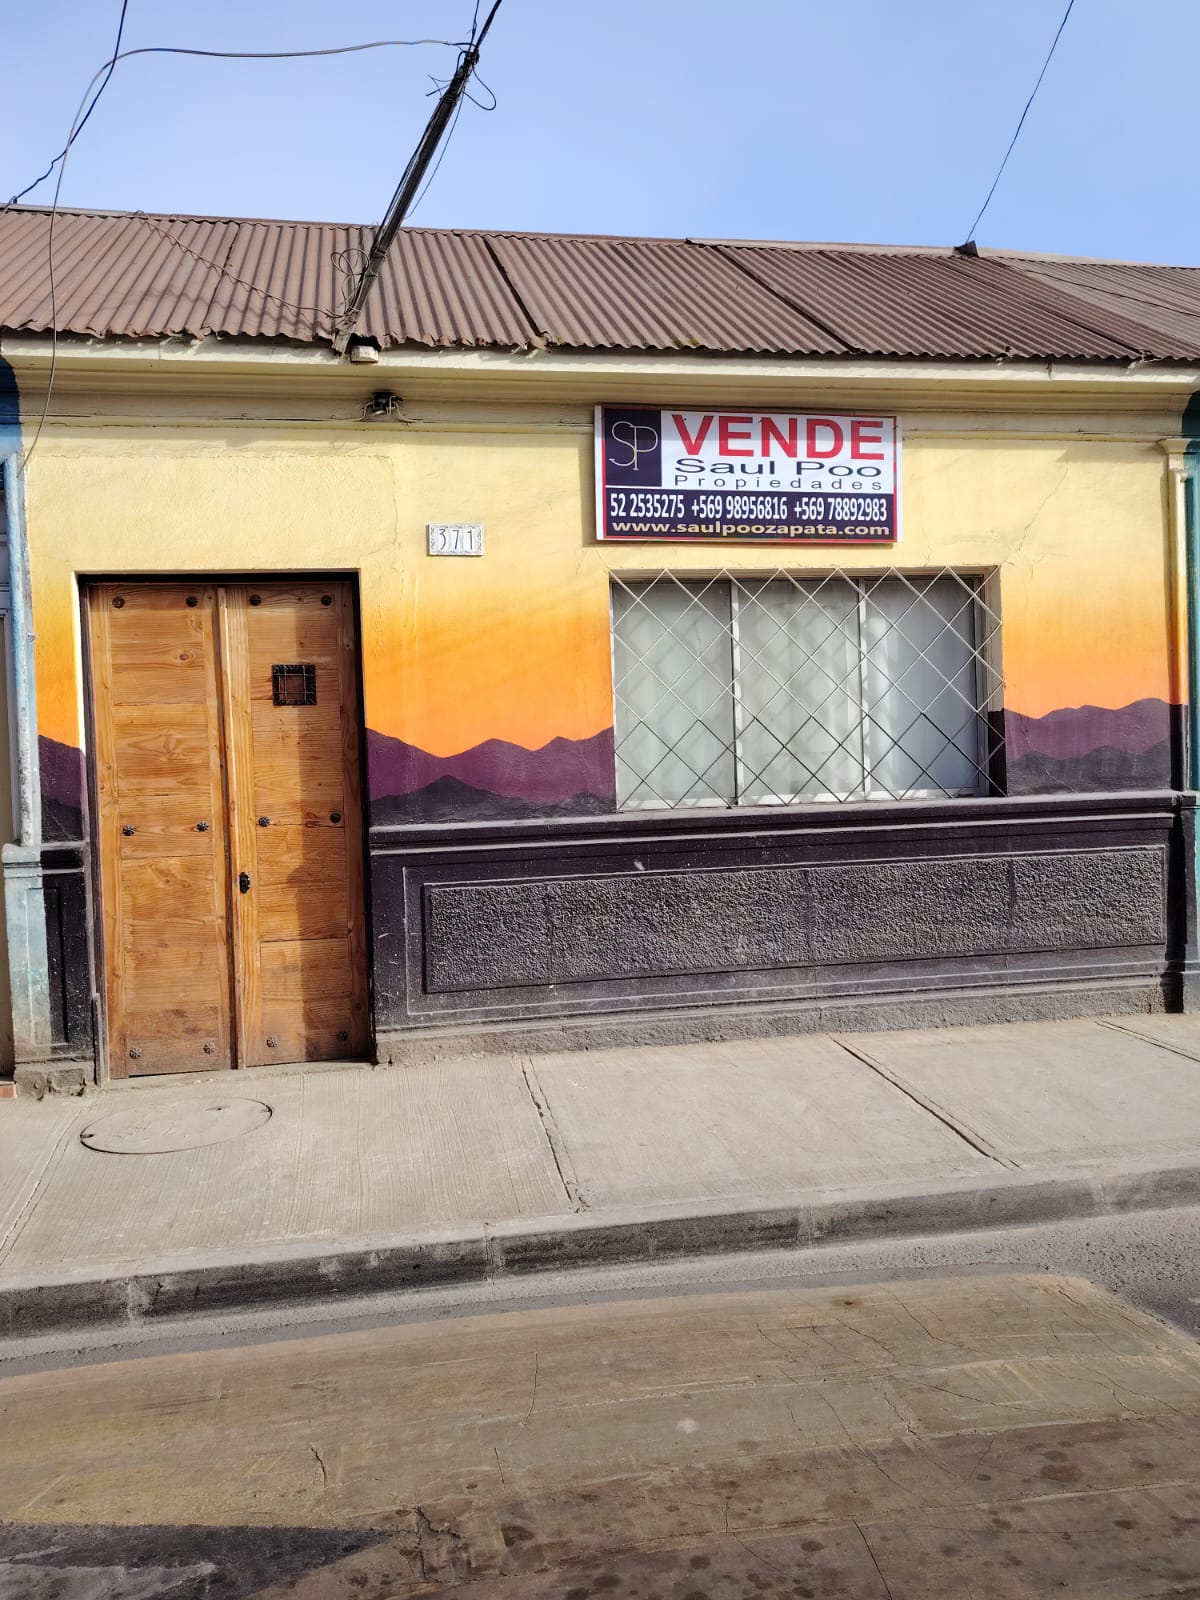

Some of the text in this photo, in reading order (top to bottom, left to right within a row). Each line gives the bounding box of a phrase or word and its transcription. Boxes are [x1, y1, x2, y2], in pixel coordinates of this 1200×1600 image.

[671, 414, 884, 460] VENDE
[675, 458, 882, 477] Saul Poo
[675, 475, 882, 490] Propiedades
[610, 493, 887, 521] 52 2535275 +569 98956816 +569 78892983
[612, 521, 889, 536] www.saulpoozapata.com
[439, 528, 473, 550] 371
